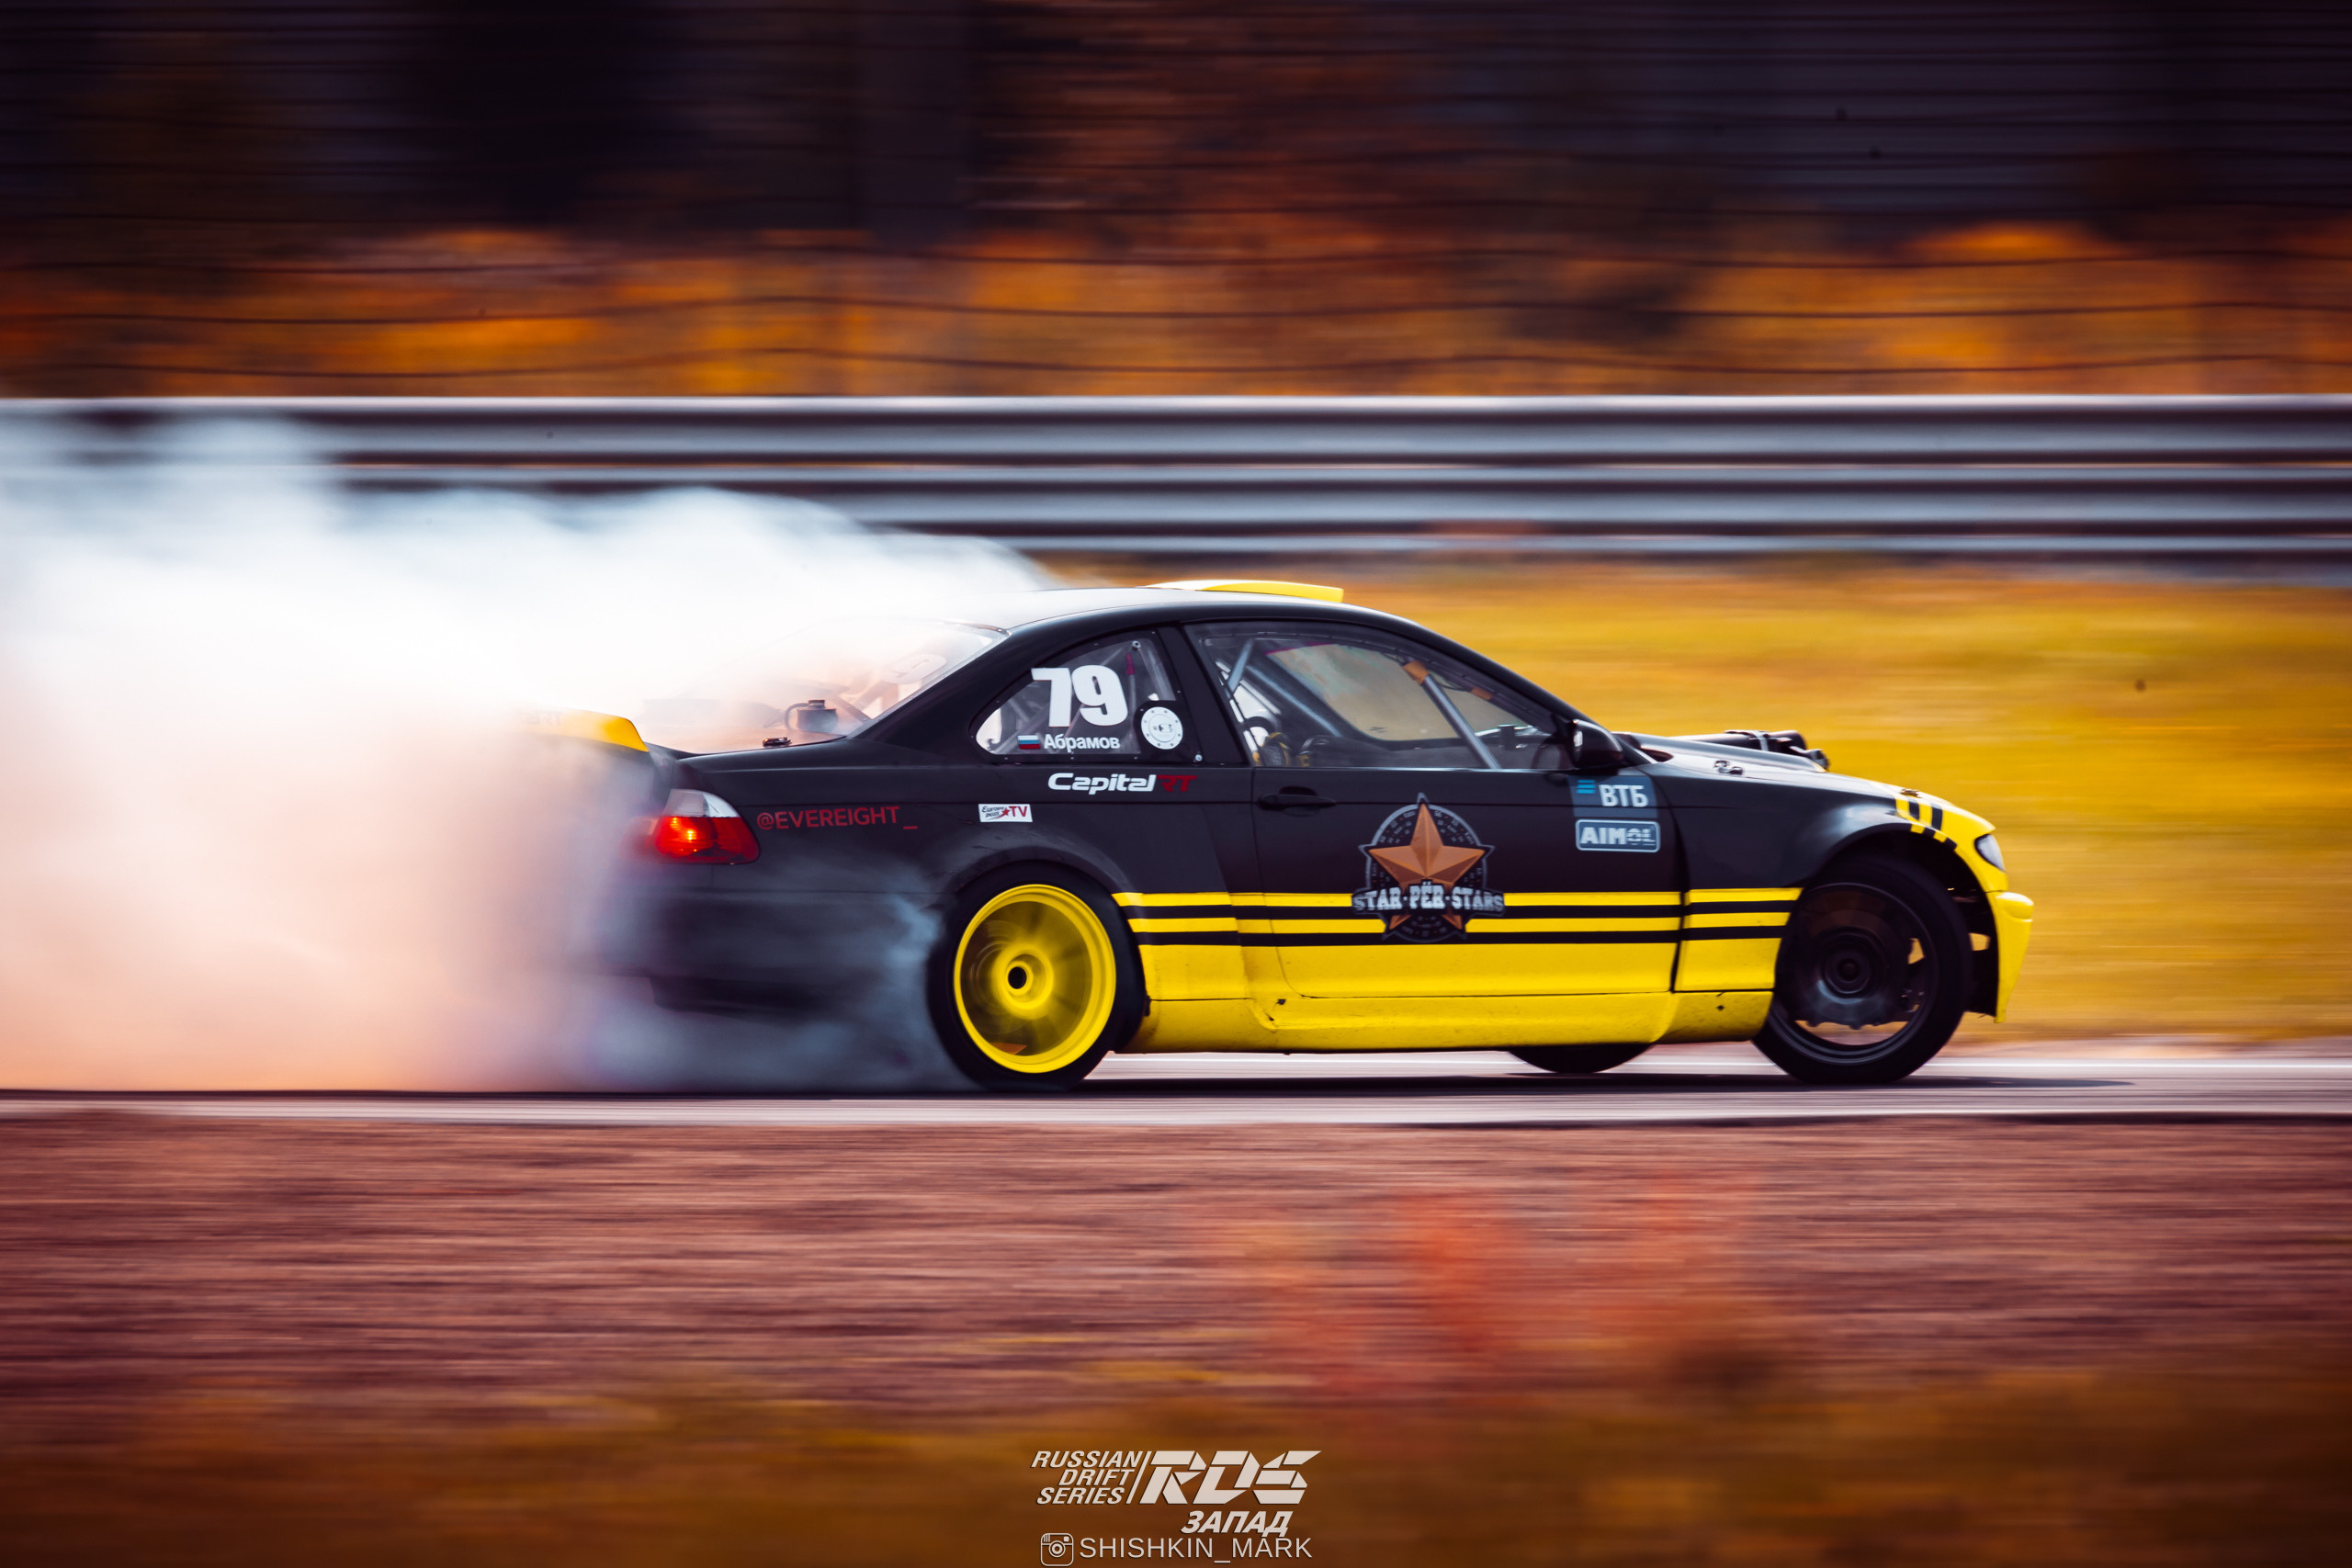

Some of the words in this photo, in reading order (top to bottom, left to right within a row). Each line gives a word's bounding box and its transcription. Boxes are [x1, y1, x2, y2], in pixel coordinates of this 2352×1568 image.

[1031, 664, 1129, 728] 79
[1043, 734, 1121, 753] Абрамов
[1599, 784, 1649, 807] ВТБ
[1009, 806, 1028, 818] TV
[1580, 827, 1657, 845] AIMOL
